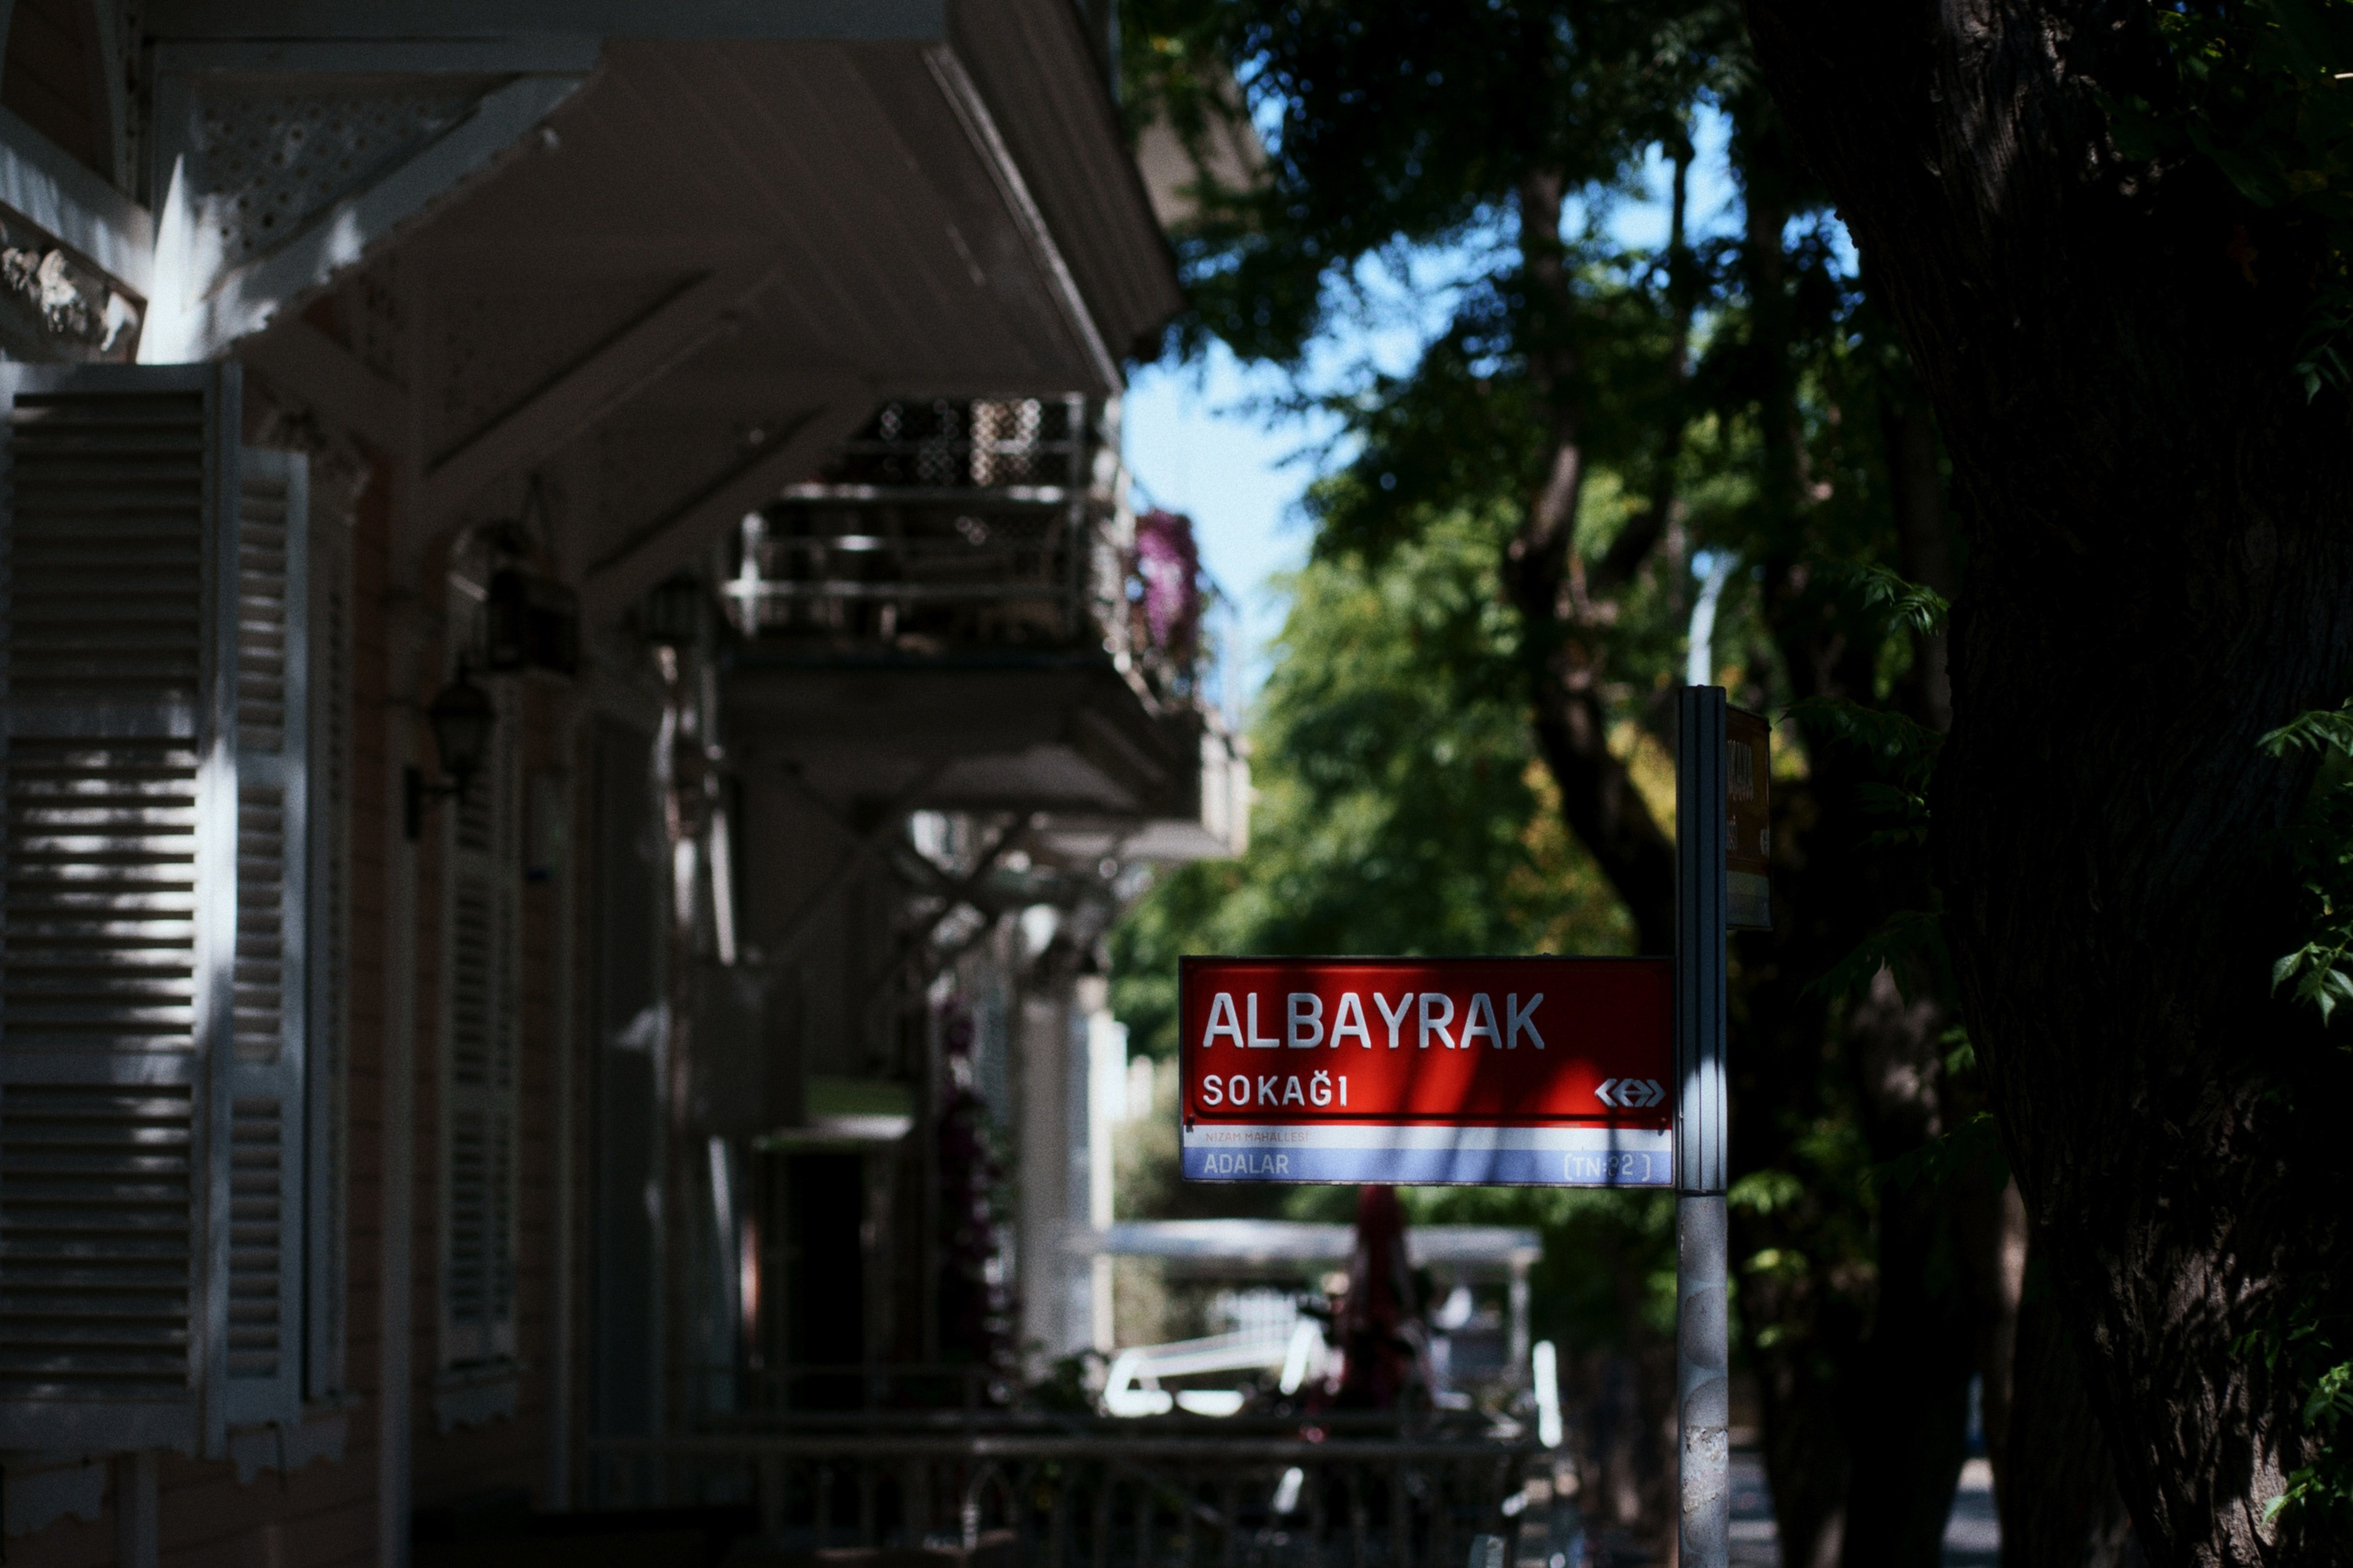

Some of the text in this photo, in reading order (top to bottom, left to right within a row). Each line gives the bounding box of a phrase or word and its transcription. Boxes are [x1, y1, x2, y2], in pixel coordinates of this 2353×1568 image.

[1202, 992, 1545, 1050] ALBAYRAK
[1202, 1070, 1347, 1107] SOKAĞI
[1203, 1153, 1290, 1175] ADALAR
